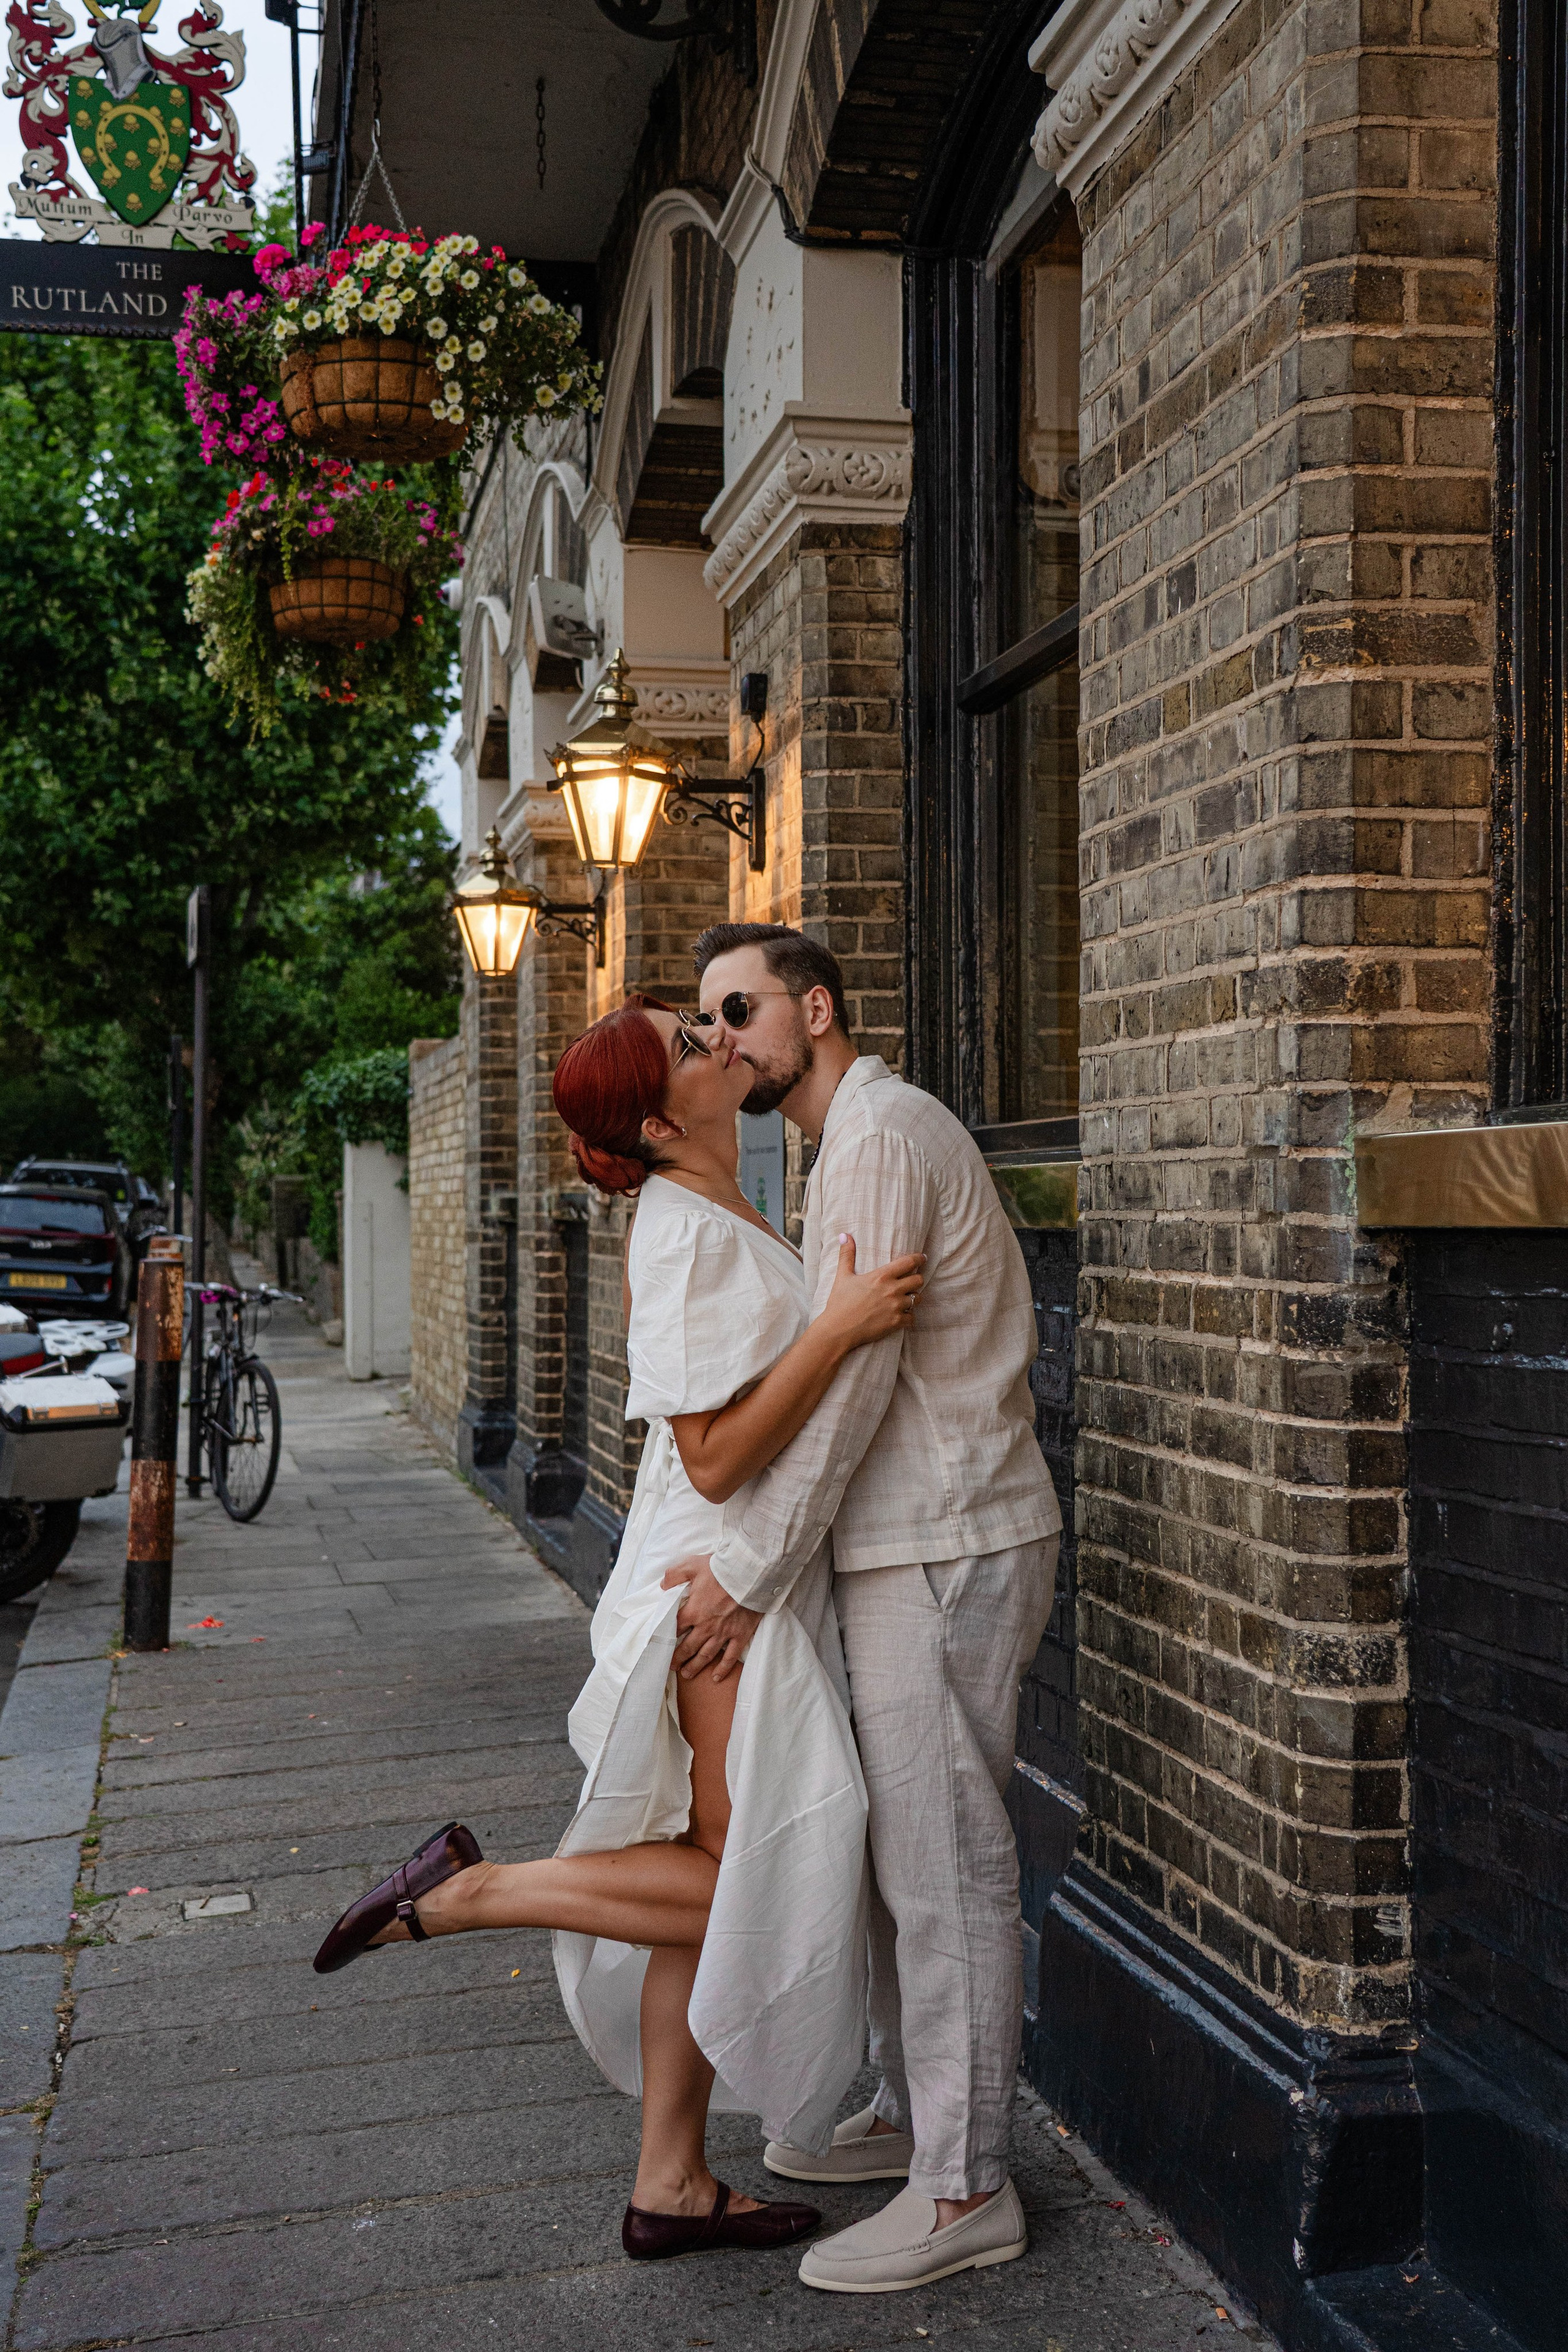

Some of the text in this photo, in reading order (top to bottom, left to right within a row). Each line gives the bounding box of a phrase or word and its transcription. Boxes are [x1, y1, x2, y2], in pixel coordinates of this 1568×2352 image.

[173, 205, 233, 224] Parvo
[122, 229, 143, 245] In
[116, 261, 163, 281] THE
[11, 285, 168, 317] RUTLAND
